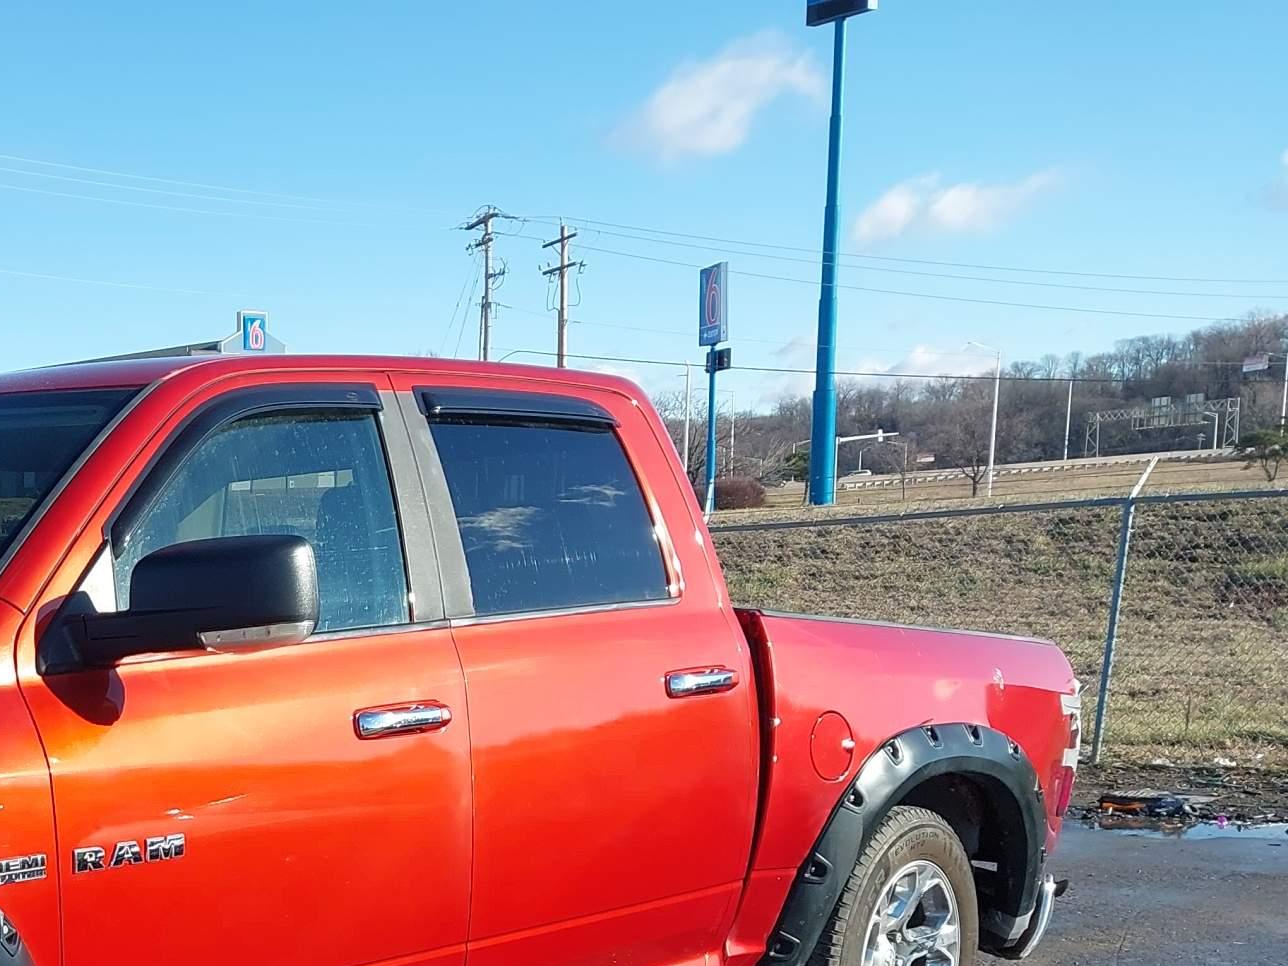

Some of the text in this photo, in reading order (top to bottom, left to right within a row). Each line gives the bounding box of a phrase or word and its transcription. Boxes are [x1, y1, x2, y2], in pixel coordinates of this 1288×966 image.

[706, 267, 720, 326] 6
[250, 319, 265, 350] 6
[72, 833, 186, 875] RAM
[894, 831, 940, 857] EVOLUTION
